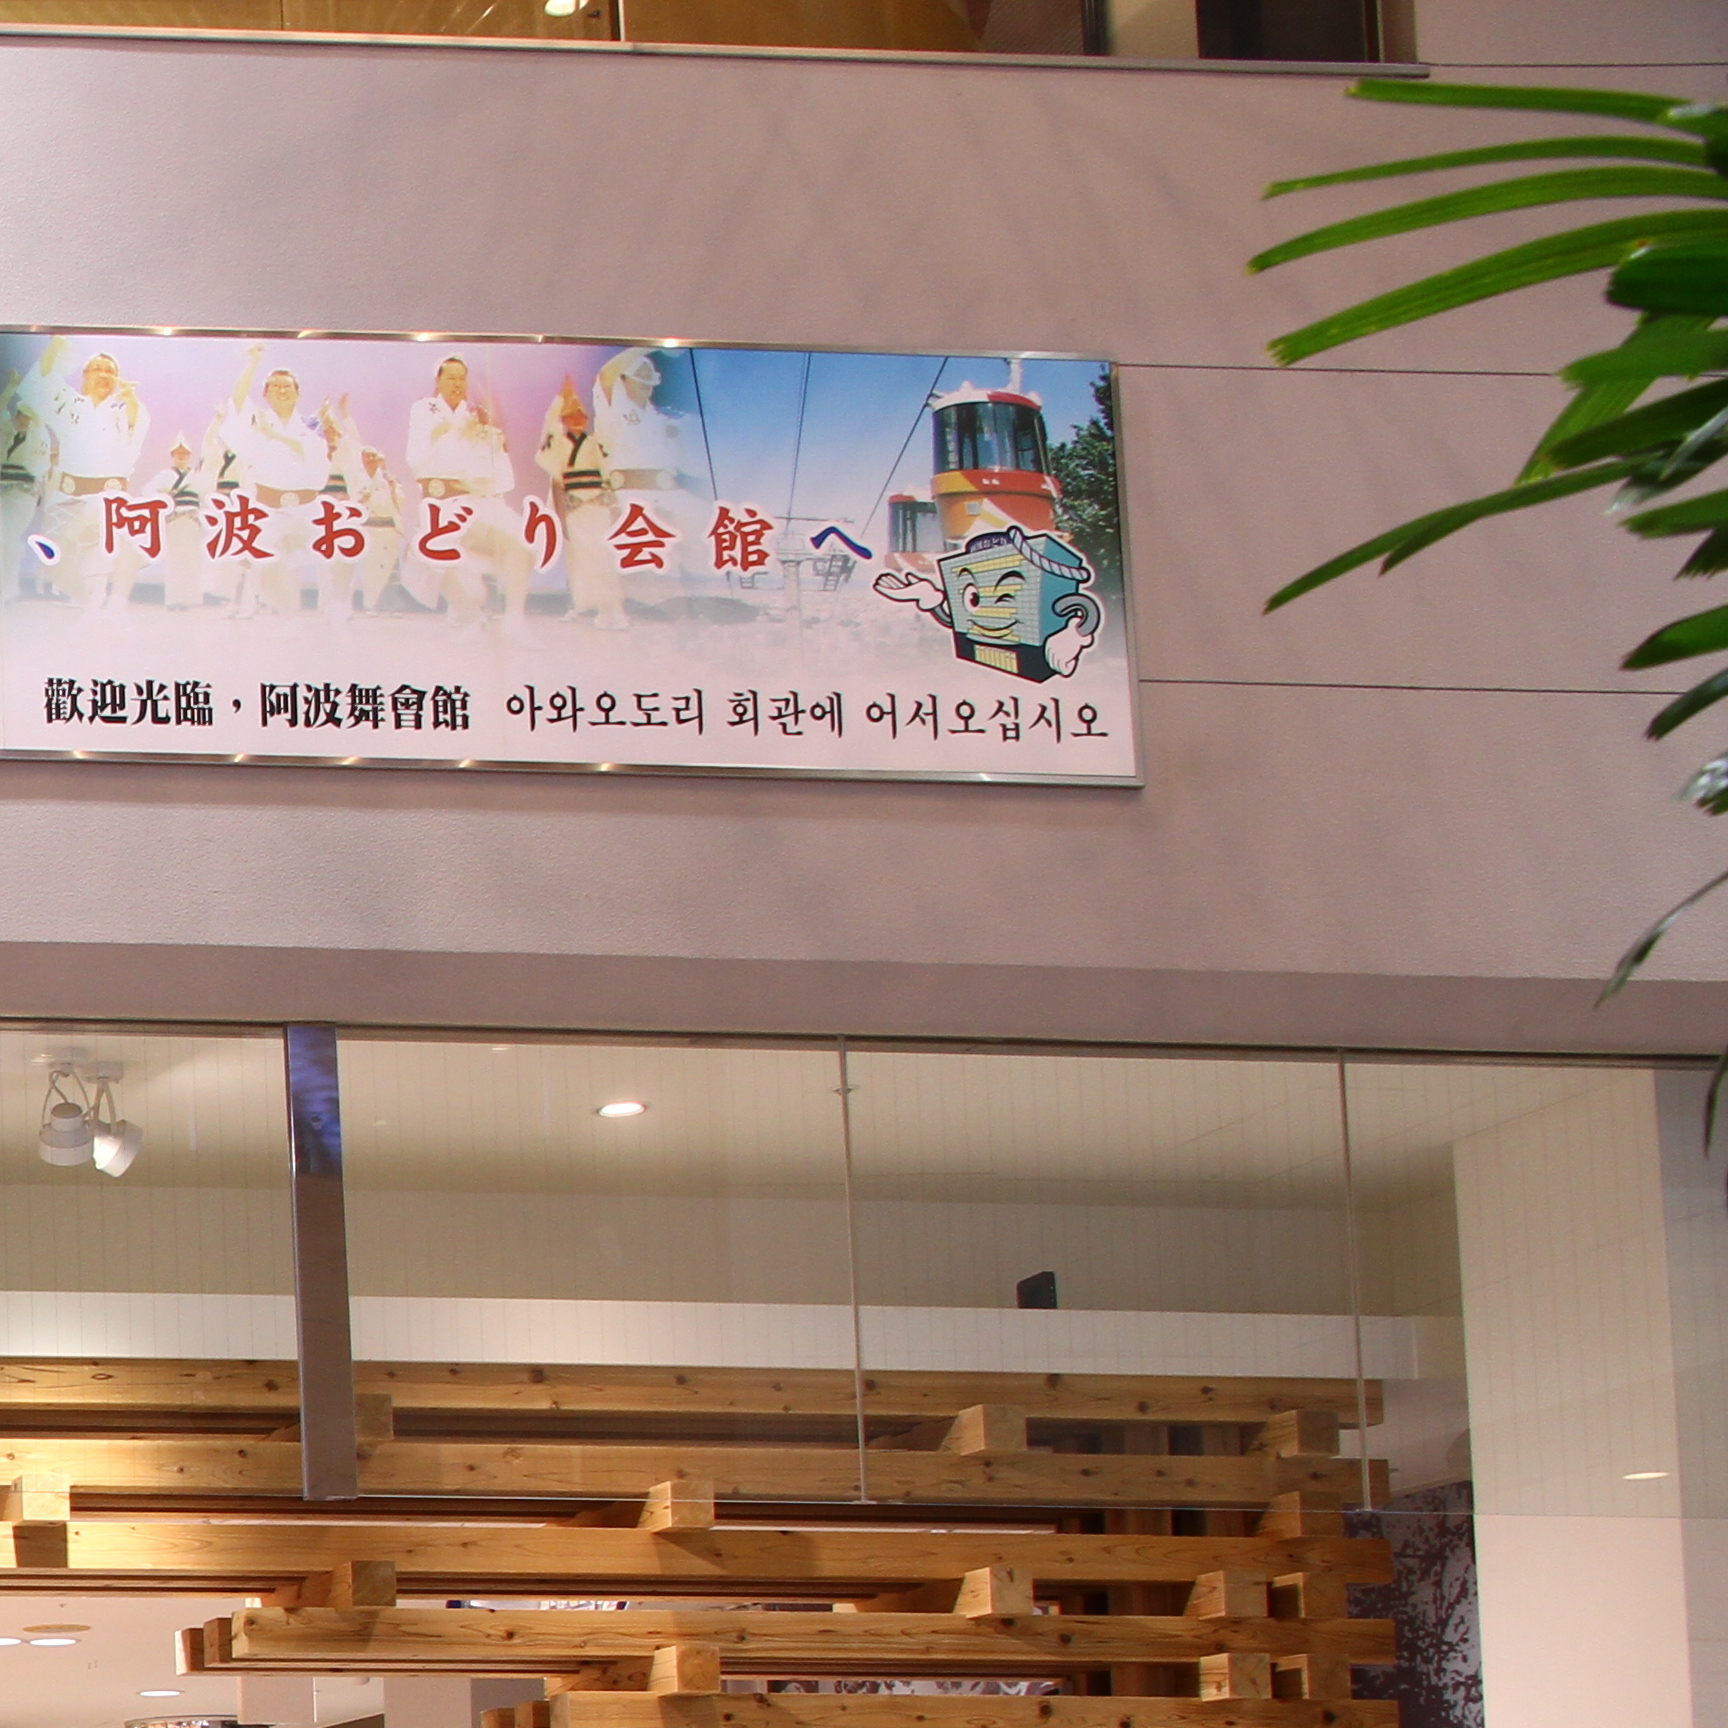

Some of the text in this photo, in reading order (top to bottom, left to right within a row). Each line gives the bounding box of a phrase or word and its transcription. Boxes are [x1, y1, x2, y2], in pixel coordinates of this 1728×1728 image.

[44, 678, 471, 732] 歡迎光臨，阿波舞會館
[506, 685, 1110, 745] 아와오도리 회관에 어서오십시오
